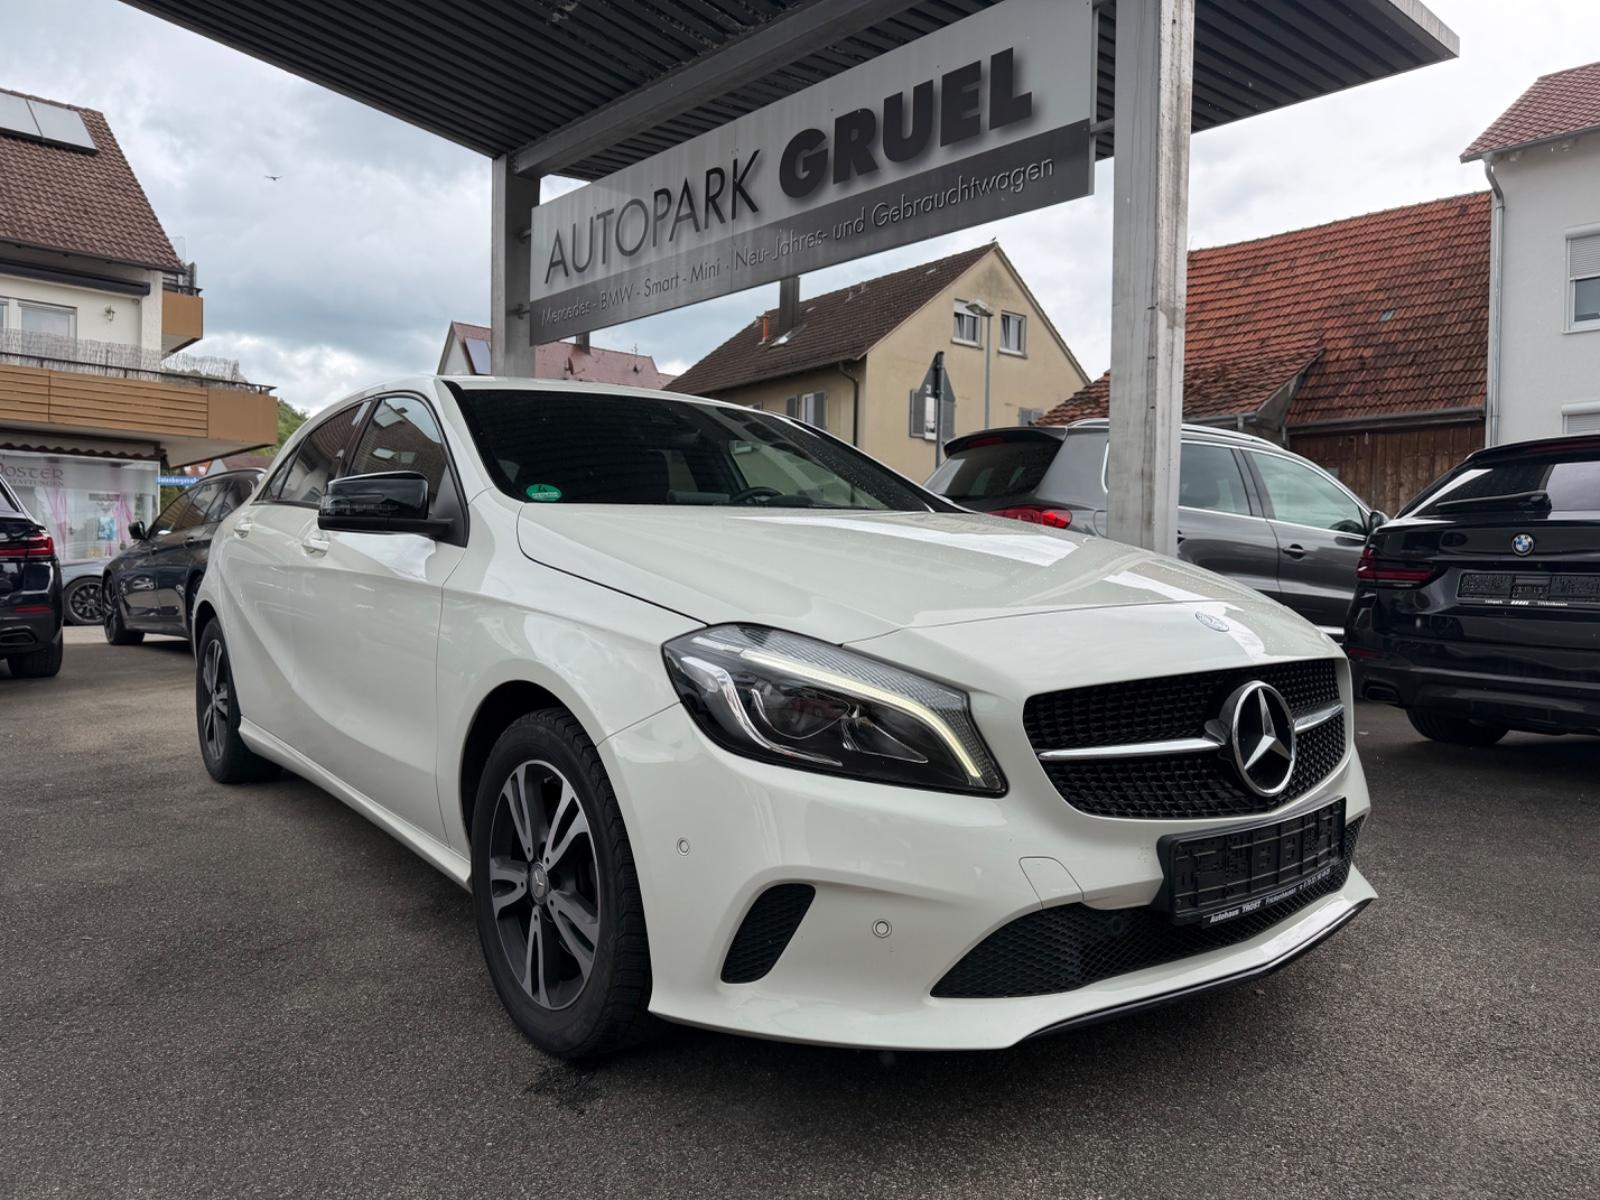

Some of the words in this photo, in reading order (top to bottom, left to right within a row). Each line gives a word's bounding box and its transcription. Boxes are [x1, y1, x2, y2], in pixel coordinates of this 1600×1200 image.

[542, 297, 590, 327] Mercedes
[601, 283, 634, 310] BMW
[644, 272, 679, 297] Smart
[690, 259, 720, 283] Mini
[832, 207, 866, 240] und
[871, 158, 1054, 226] Gebrauchtwagen
[545, 149, 761, 284] AUTOPARK
[779, 47, 1033, 198] GRUEL
